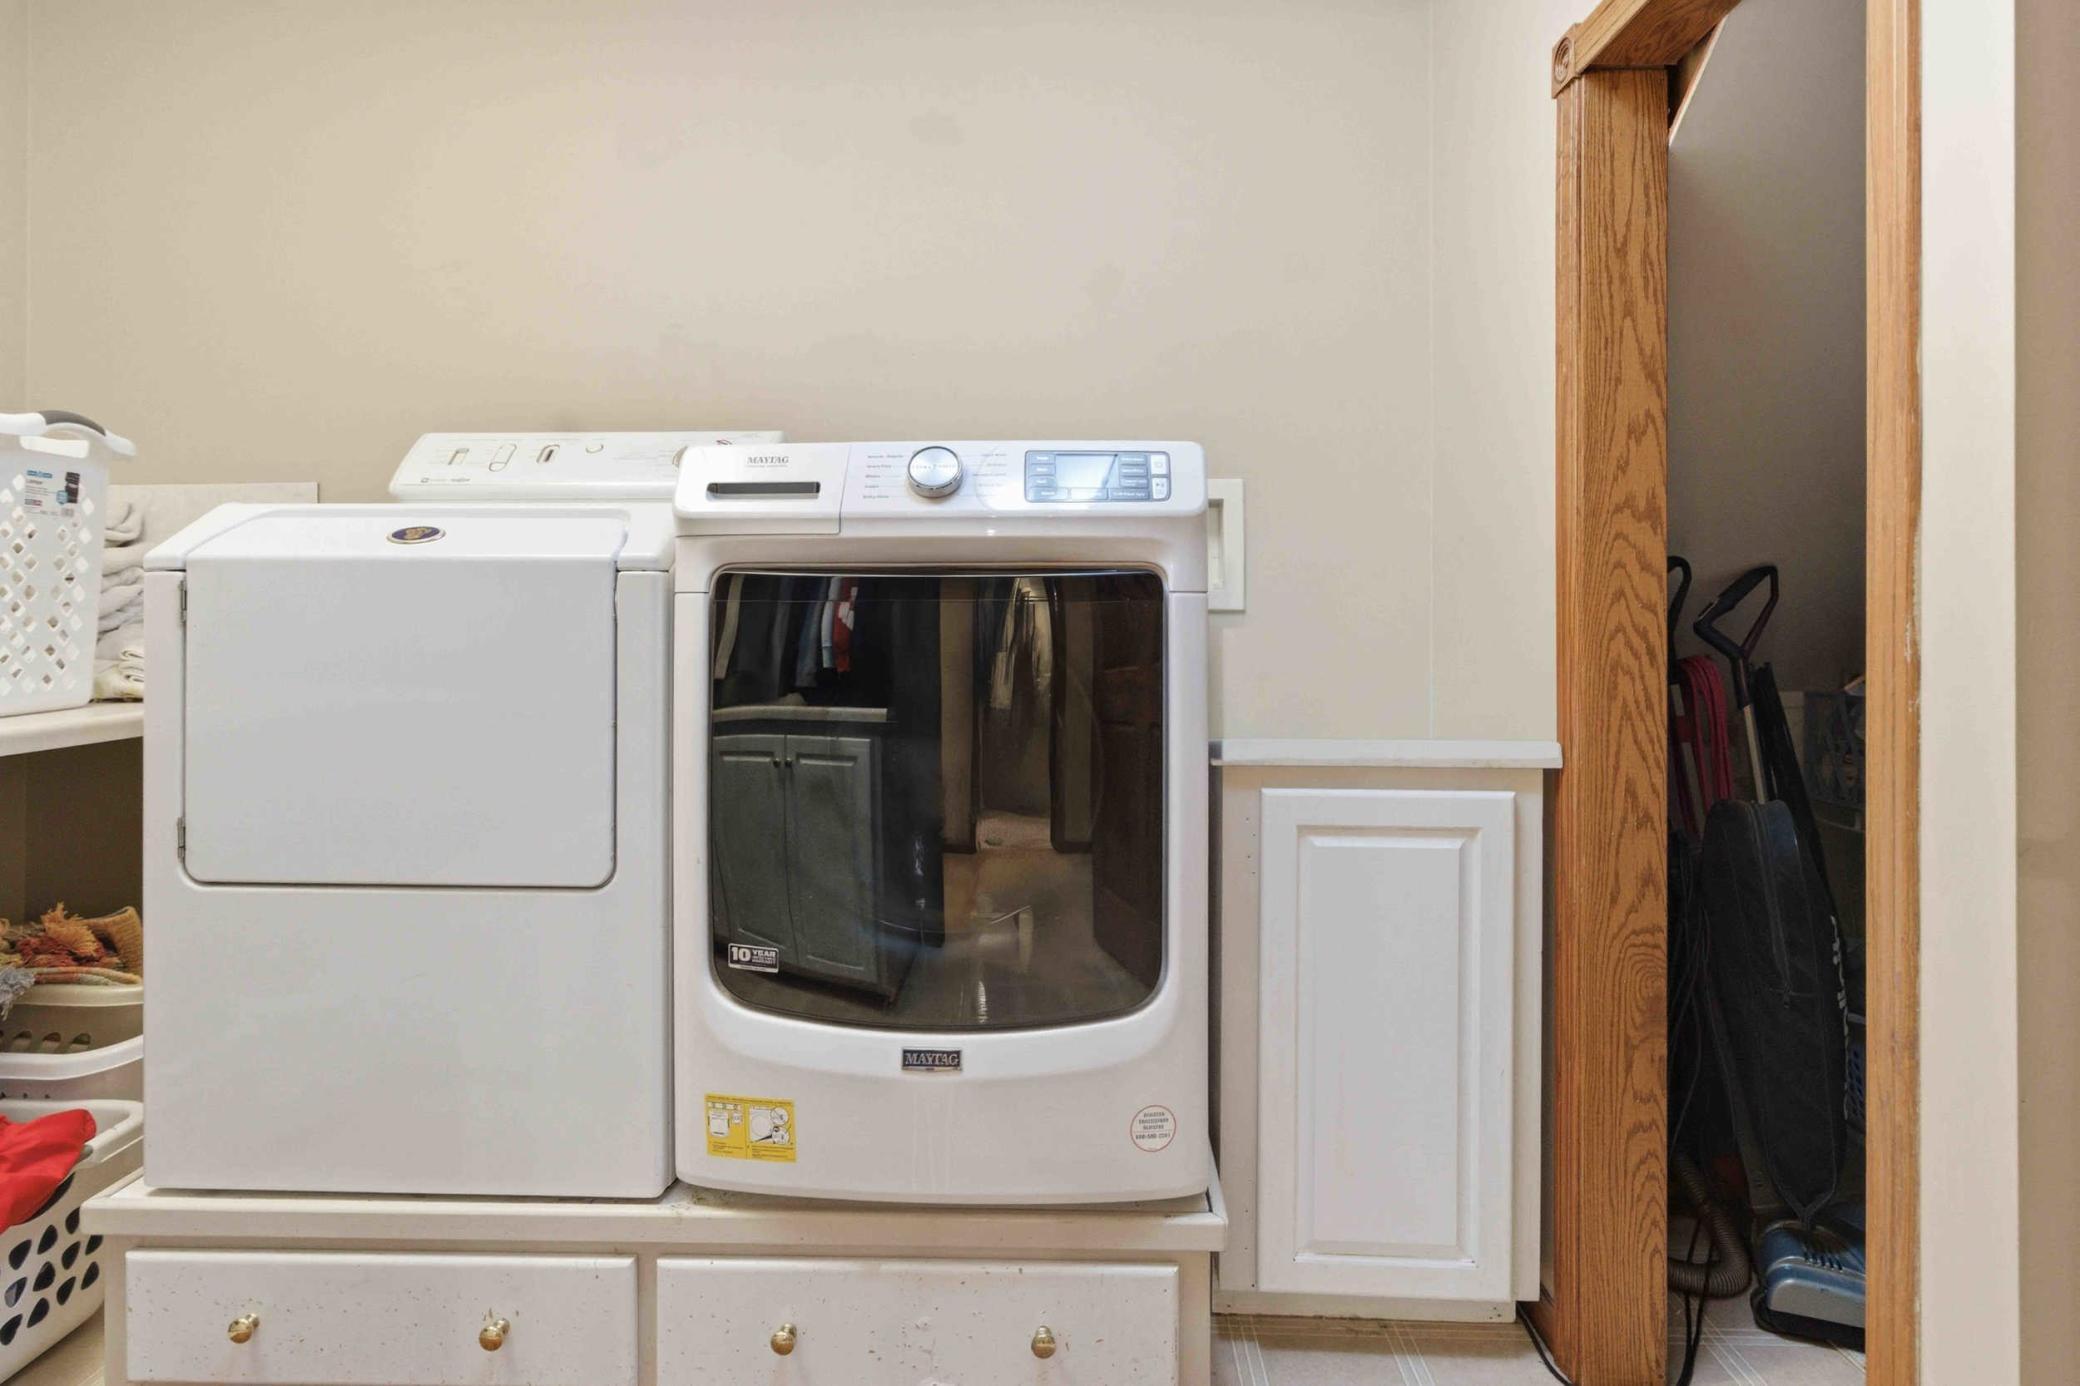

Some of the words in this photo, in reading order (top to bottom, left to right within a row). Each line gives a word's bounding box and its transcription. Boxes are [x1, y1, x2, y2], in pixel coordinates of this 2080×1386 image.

[747, 456, 789, 464] MAYTAG
[732, 947, 751, 962] 10
[752, 949, 776, 957] YEAR
[905, 1052, 959, 1066] MAYTAG
